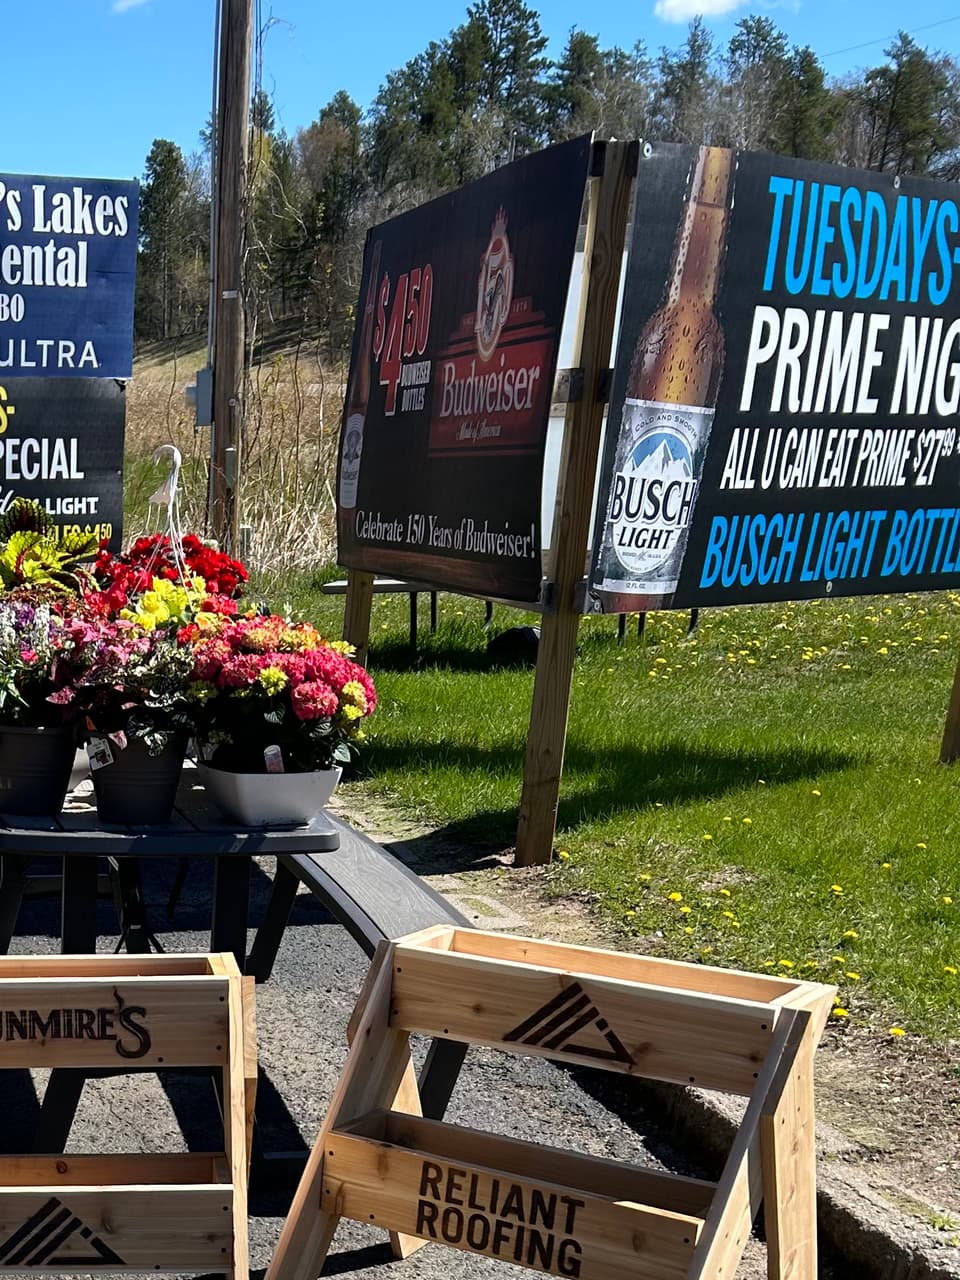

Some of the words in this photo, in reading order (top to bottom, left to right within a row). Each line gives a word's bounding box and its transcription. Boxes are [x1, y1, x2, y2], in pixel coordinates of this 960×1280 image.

[32, 184, 129, 237] Lakes
[440, 352, 540, 417] Budweiser
[739, 305, 890, 413] PRIME
[719, 428, 760, 490] ALL
[761, 427, 783, 489] U
[779, 427, 824, 488] CAN
[818, 428, 859, 488] EAT
[852, 428, 916, 488] PRIME
[45, 497, 99, 514] LIGHT
[609, 473, 696, 527] BUSCH
[355, 510, 404, 542] Celebrate
[406, 513, 426, 545] 150
[428, 515, 452, 549] Years
[454, 518, 466, 550] of
[465, 518, 536, 559] Budweiser!
[618, 526, 674, 549] LIGHT
[700, 512, 804, 588] BUSCH
[800, 510, 887, 581] LIGHT
[881, 508, 960, 577] BOTTL
[419, 1161, 585, 1235] RELIANT
[416, 1199, 582, 1278] ROOFING
